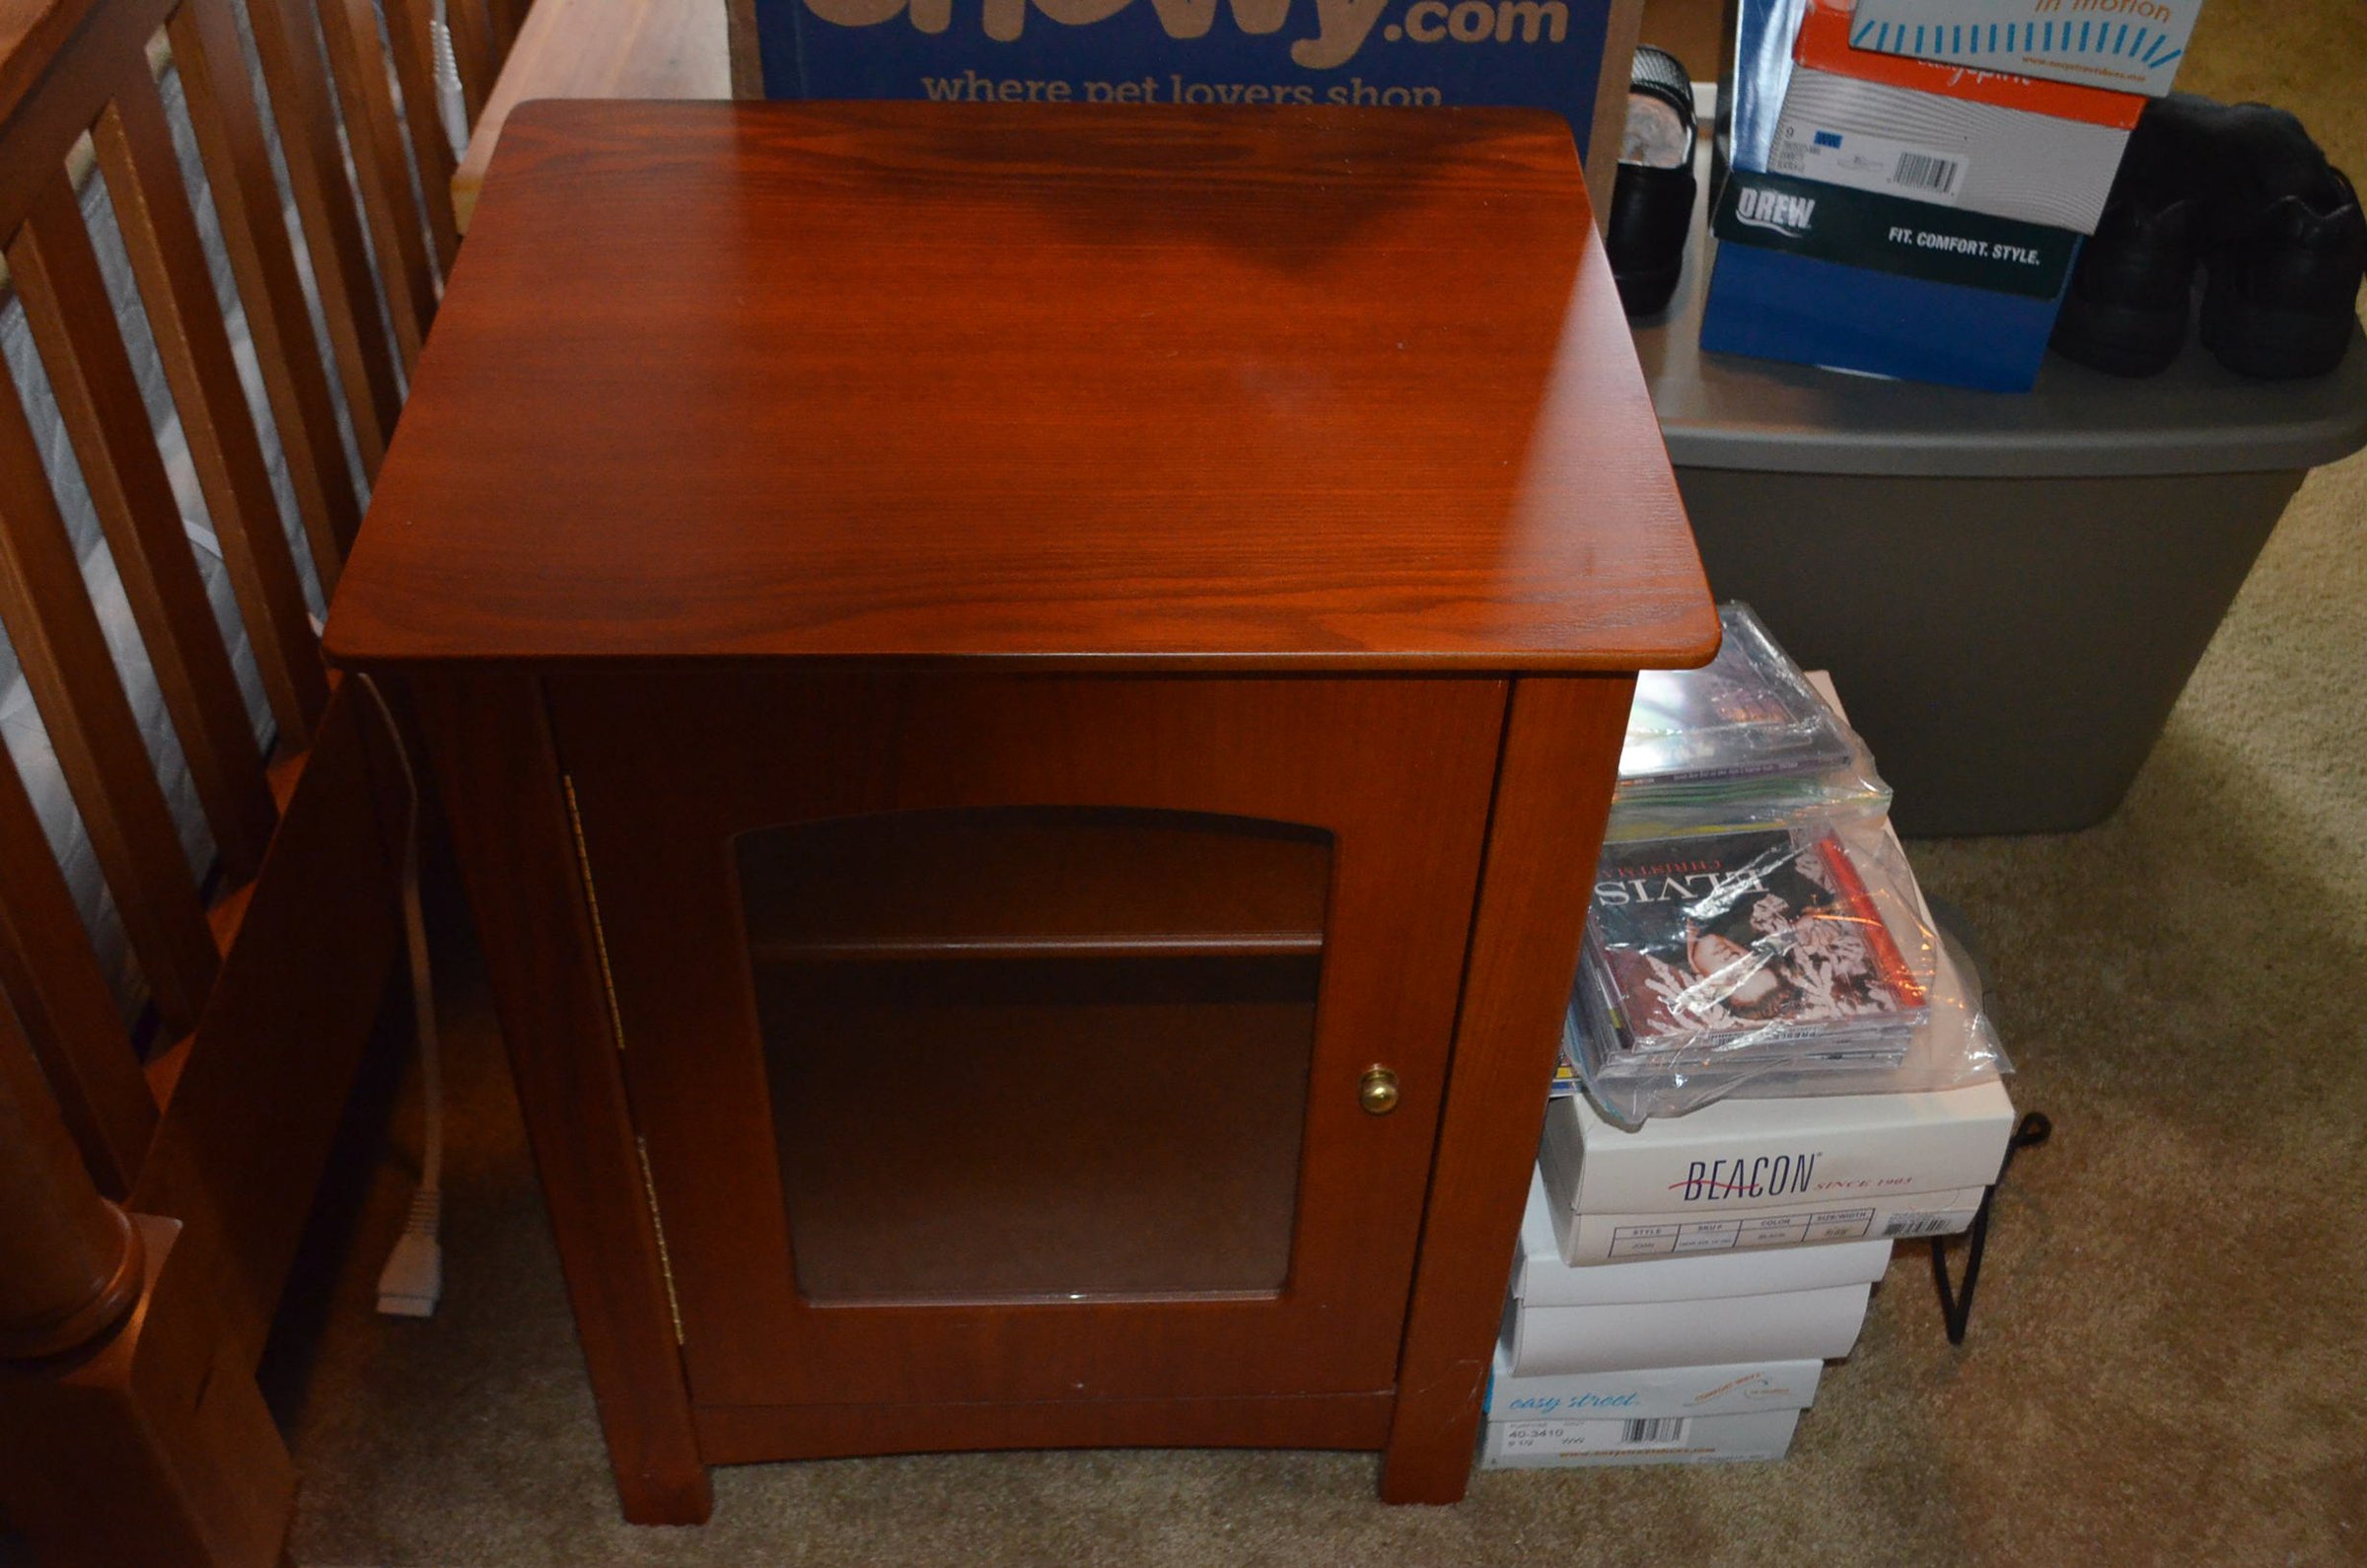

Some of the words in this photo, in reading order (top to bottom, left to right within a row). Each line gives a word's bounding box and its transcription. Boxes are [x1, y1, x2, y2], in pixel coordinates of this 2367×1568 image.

[920, 70, 1073, 103] where
[1084, 75, 1159, 104] pet
[1170, 75, 1315, 106] lovers
[1327, 77, 1443, 107] shop
[1737, 186, 1817, 229] DREW
[1889, 227, 1912, 246] FIT.
[1916, 232, 1989, 258] COMFORT.
[1992, 244, 2041, 265] STYLE.
[1594, 869, 1770, 906] ELVIS
[1683, 1153, 1816, 1201] BEACON
[1509, 1396, 1561, 1414] easy
[1568, 1391, 1638, 1408] street
